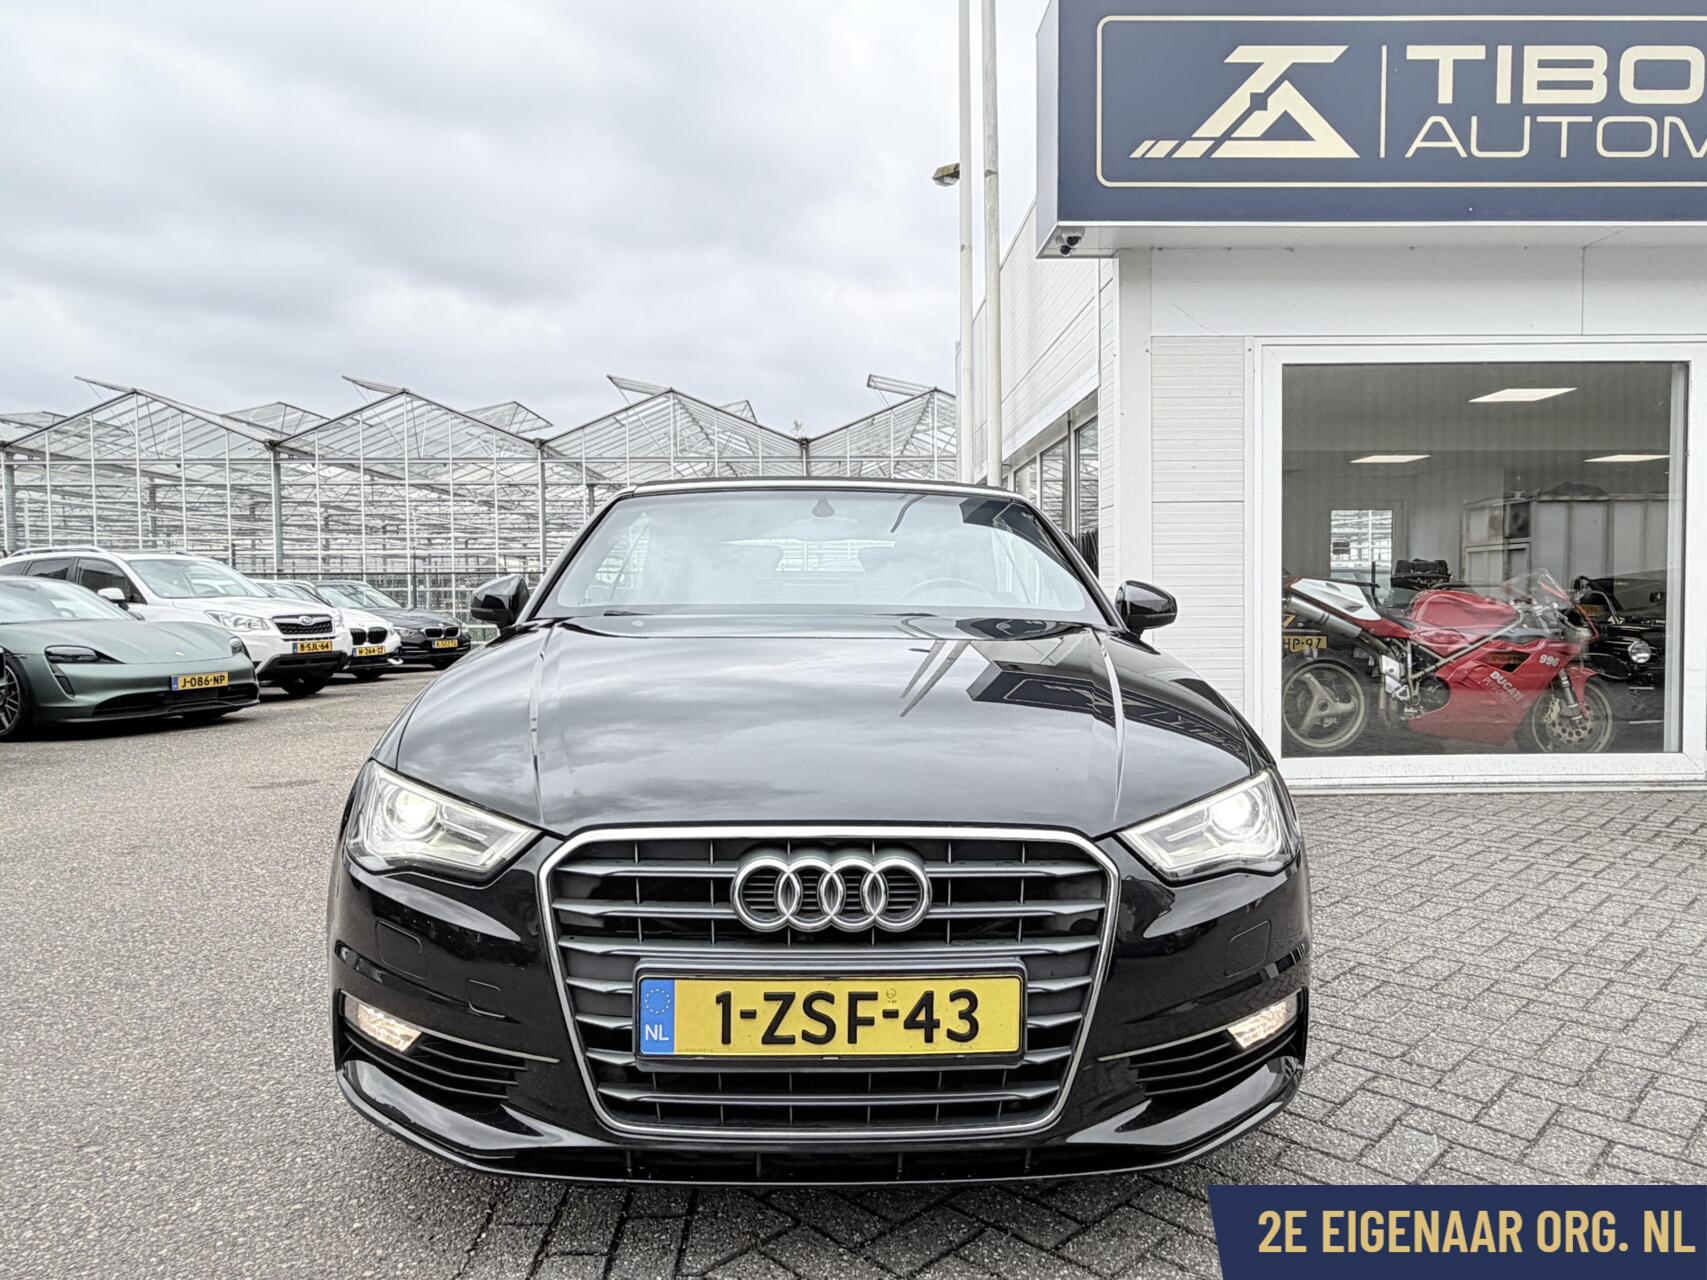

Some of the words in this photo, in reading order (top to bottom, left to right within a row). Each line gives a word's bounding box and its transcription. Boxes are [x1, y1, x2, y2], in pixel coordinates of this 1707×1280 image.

[1405, 44, 1706, 105] TIBO
[180, 674, 226, 689] J-086-NP
[1489, 670, 1525, 701] DUCATI
[715, 988, 980, 1045] 1-ZSF-43
[645, 1025, 670, 1041] NL
